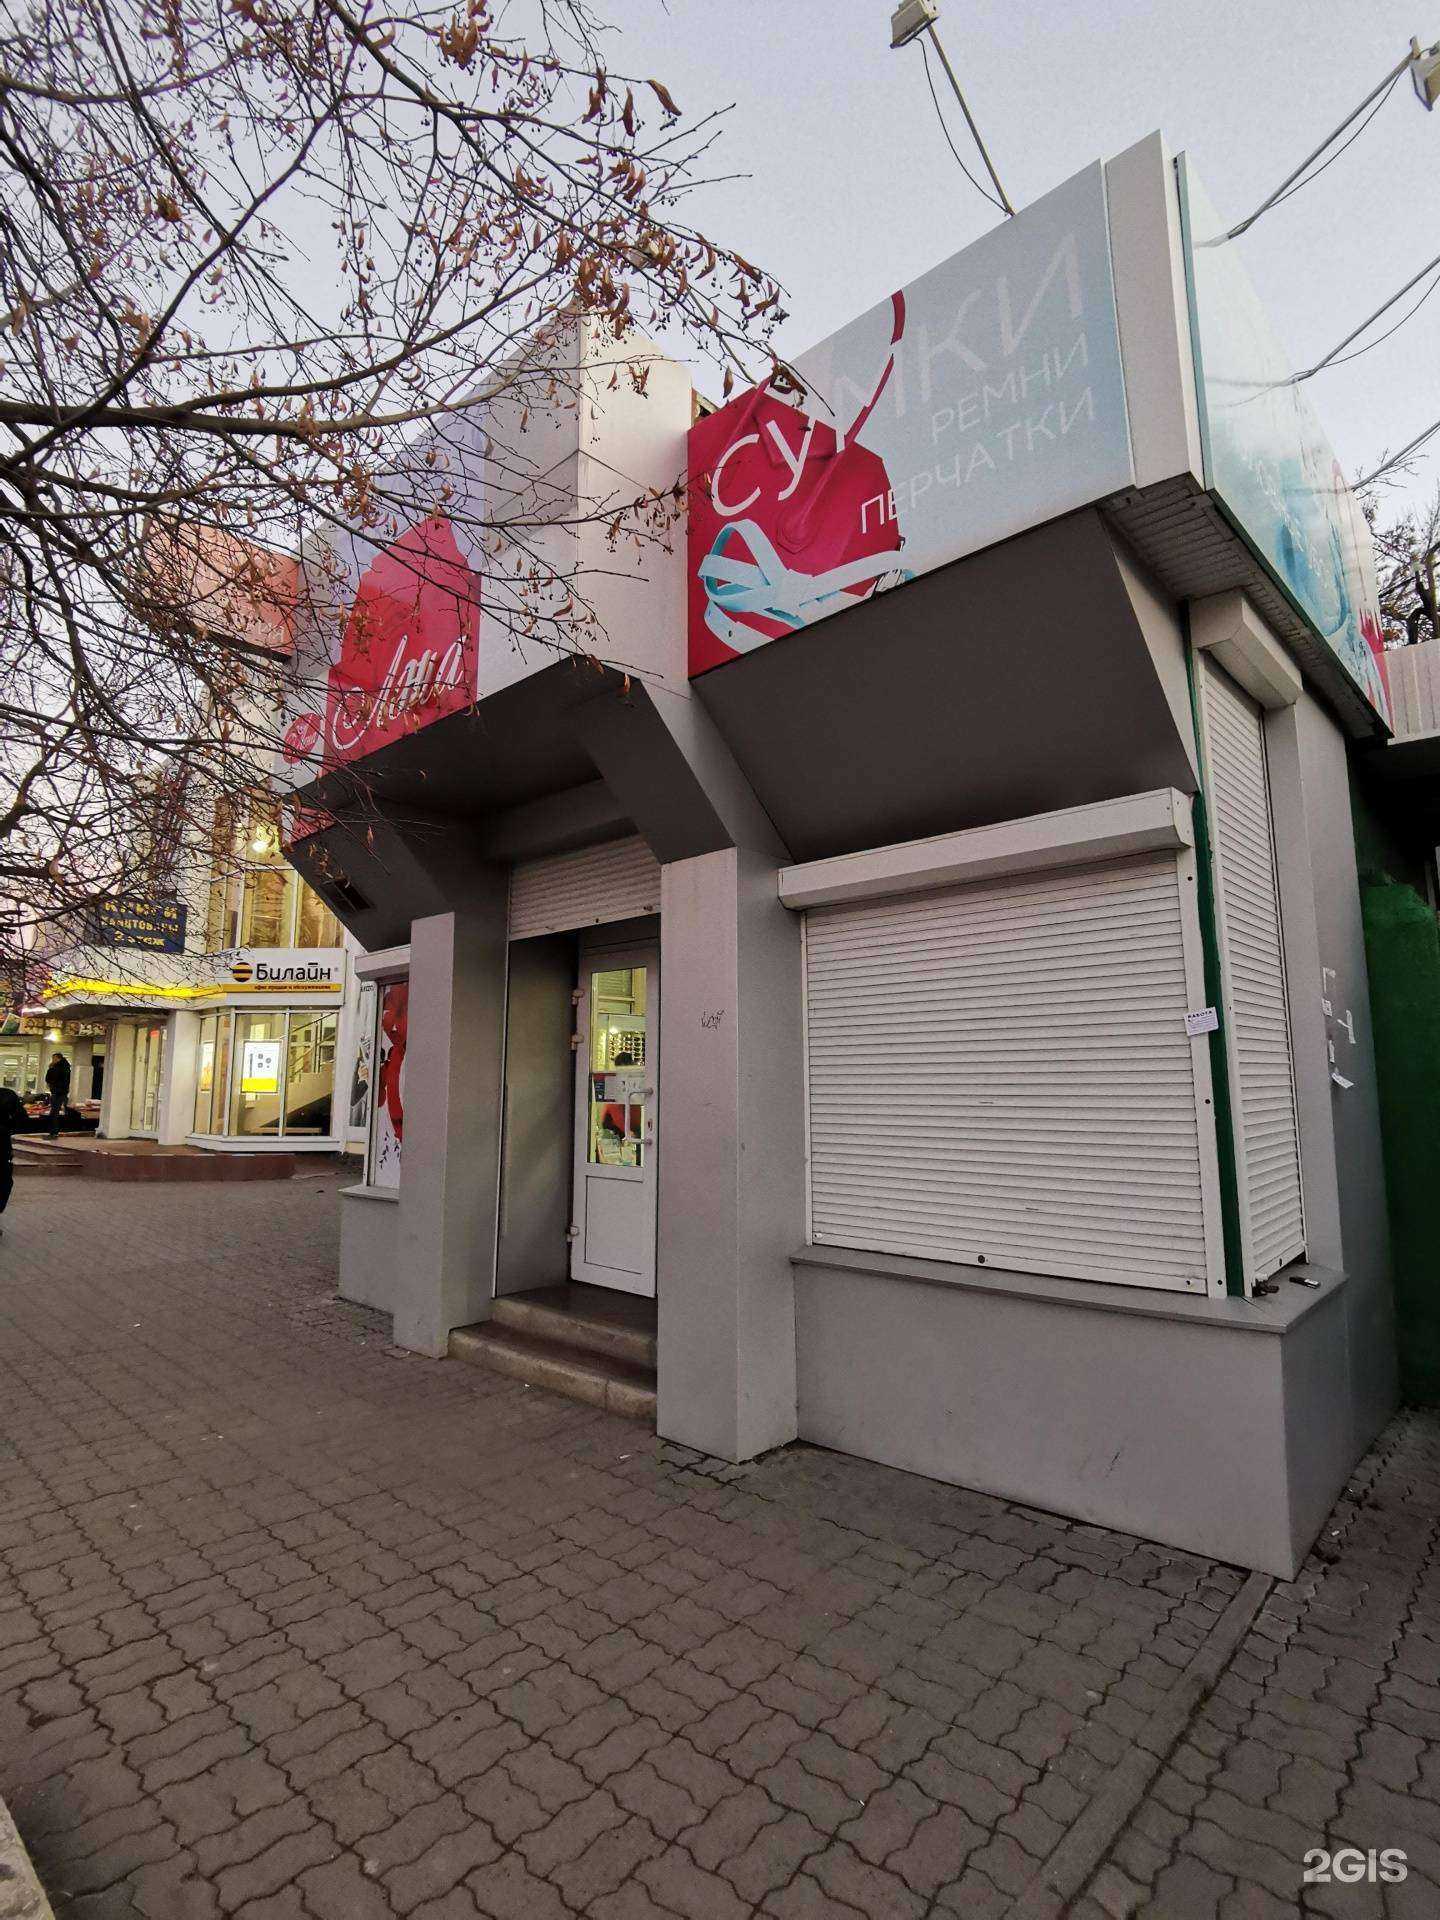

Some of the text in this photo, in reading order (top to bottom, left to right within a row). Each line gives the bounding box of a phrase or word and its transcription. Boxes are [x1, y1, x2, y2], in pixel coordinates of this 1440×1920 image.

[932, 332, 1088, 443] РЕМНИ
[860, 387, 1095, 534] ПЕРЧАТКИ
[256, 962, 331, 980] Билайн
